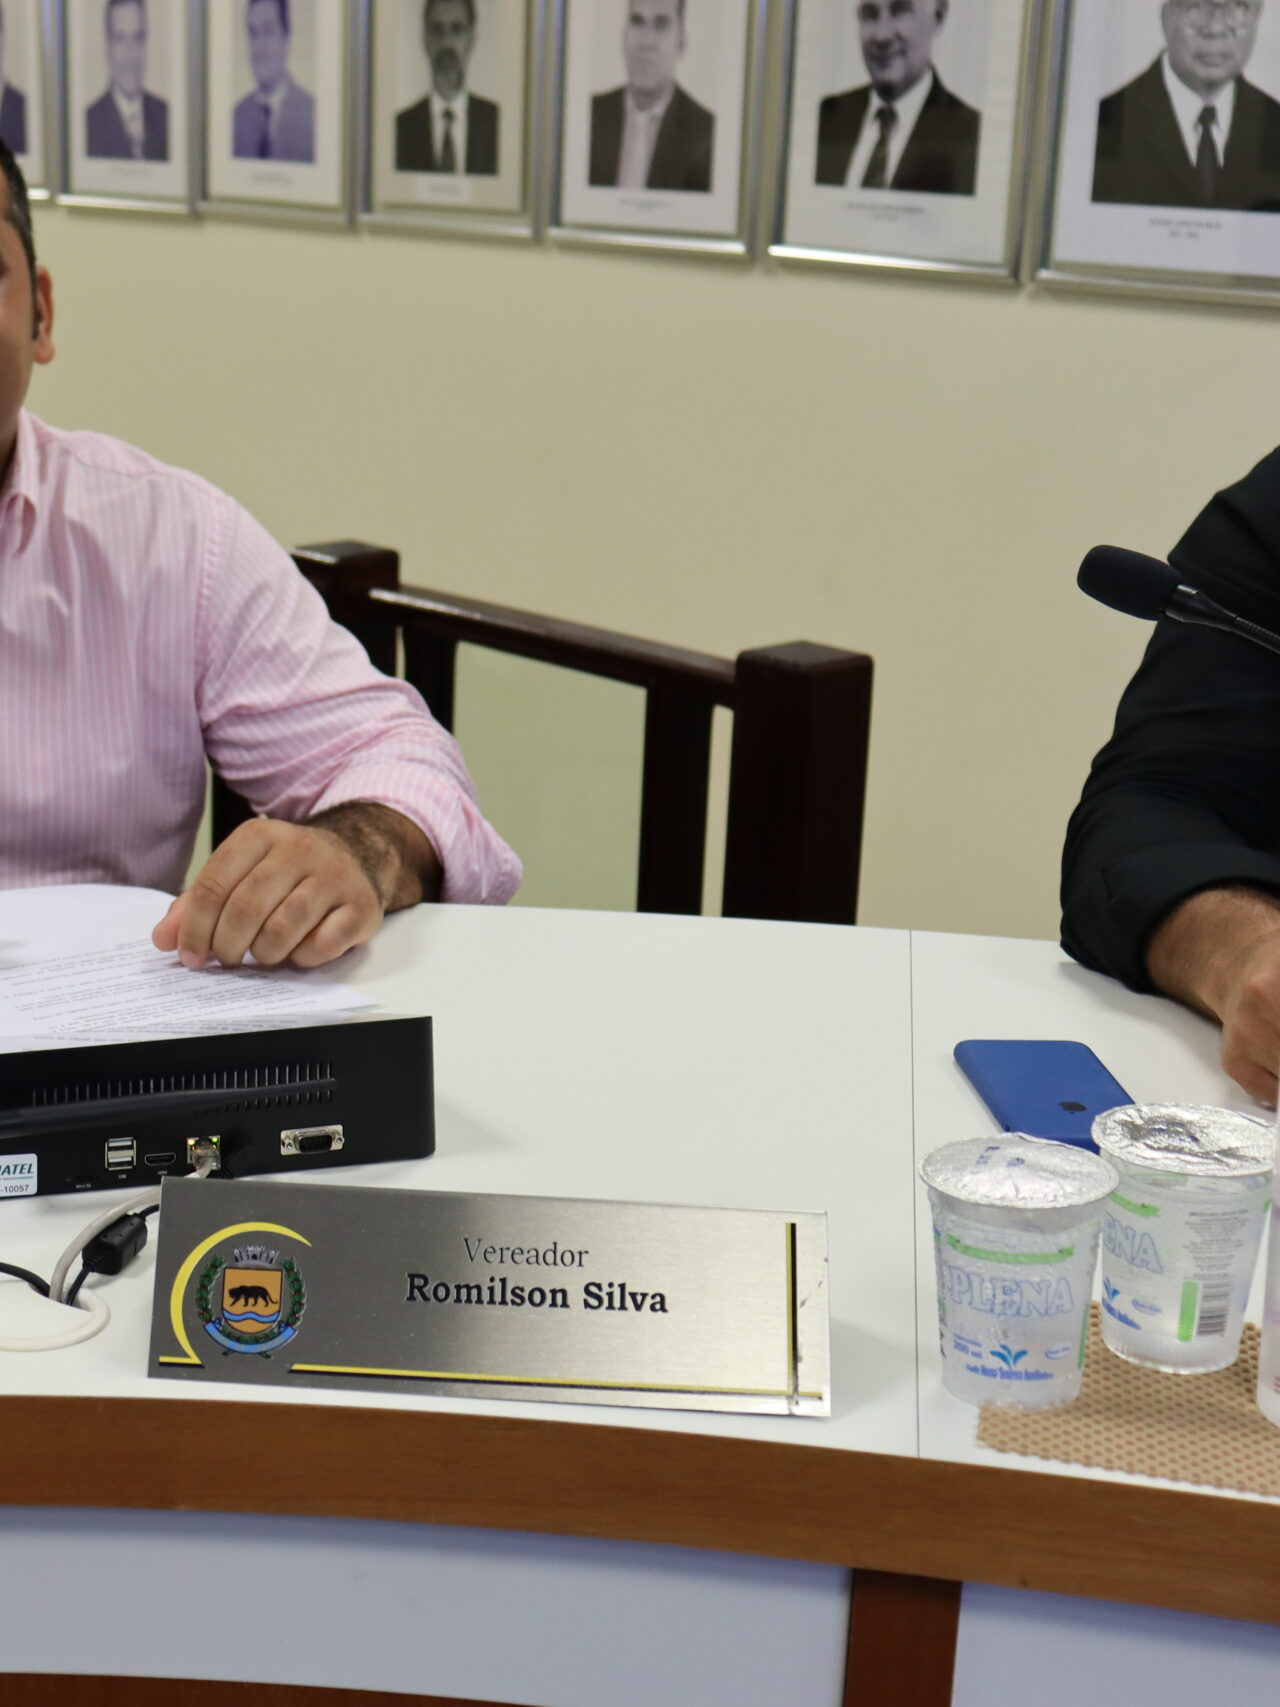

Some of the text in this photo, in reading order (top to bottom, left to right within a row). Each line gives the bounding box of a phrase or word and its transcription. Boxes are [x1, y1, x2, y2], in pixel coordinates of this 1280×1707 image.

[463, 1237, 590, 1268] Vereador
[1103, 1212, 1163, 1274] ENA
[406, 1273, 668, 1313] Romilson Silva
[948, 1265, 1075, 1318] PLENA
